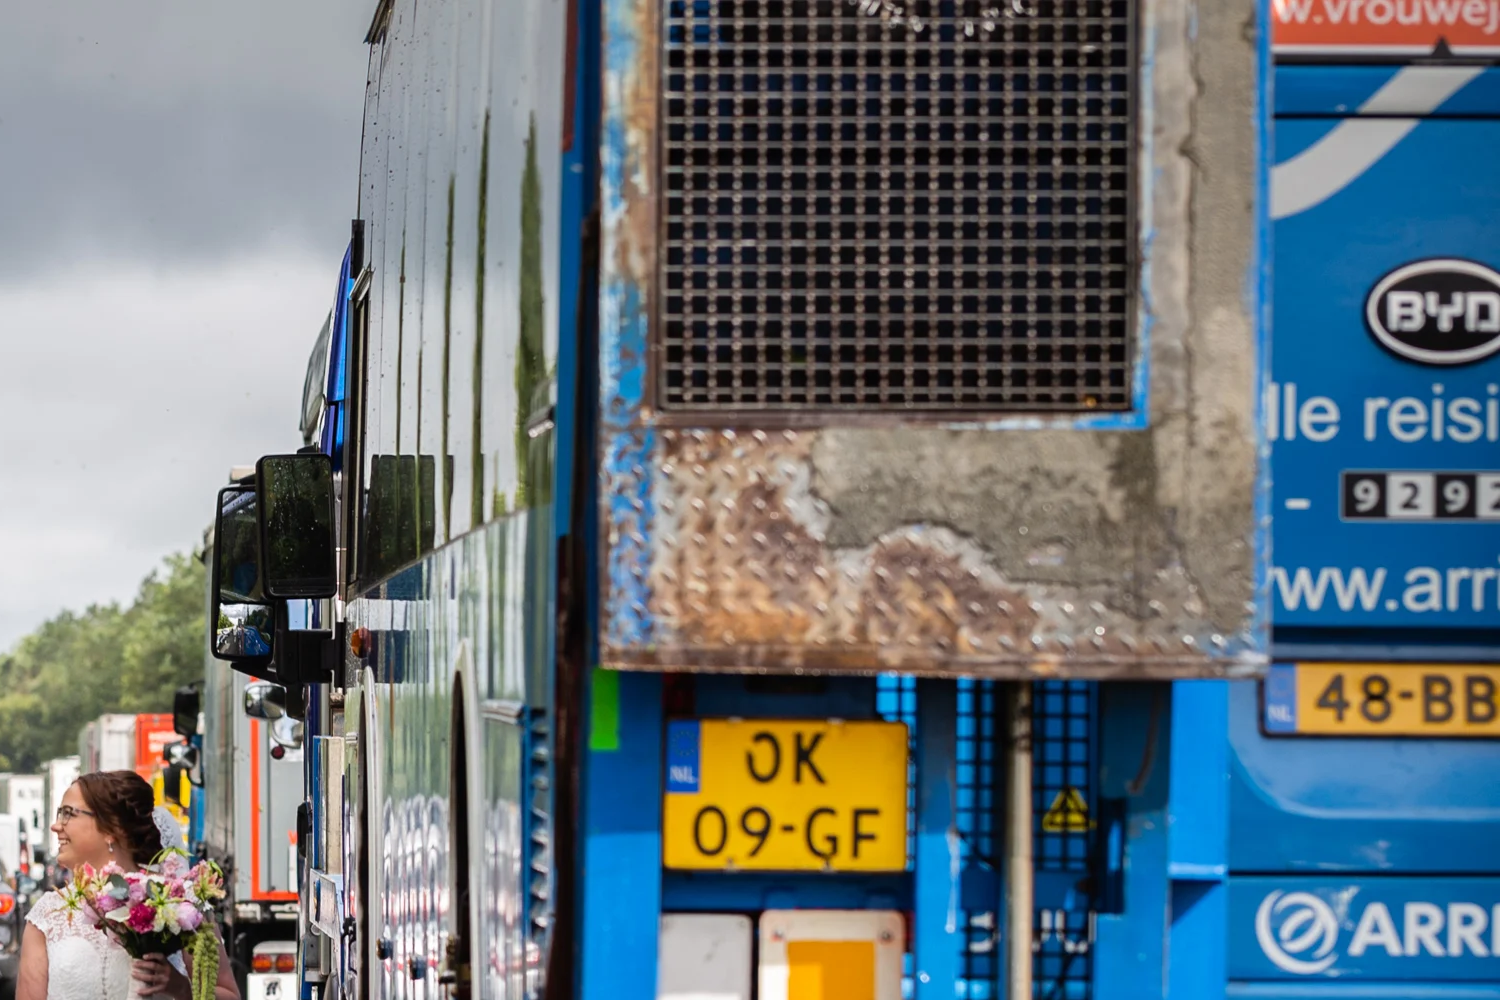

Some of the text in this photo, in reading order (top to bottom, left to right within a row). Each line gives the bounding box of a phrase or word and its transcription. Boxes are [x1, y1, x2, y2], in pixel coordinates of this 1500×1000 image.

[1386, 290, 1500, 332] BYD
[1363, 382, 1499, 443] reisi
[1267, 554, 1500, 612] ww.arr
[1267, 673, 1497, 723] NL 48-BB
[669, 766, 698, 784] NL
[693, 805, 880, 858] 09-GF
